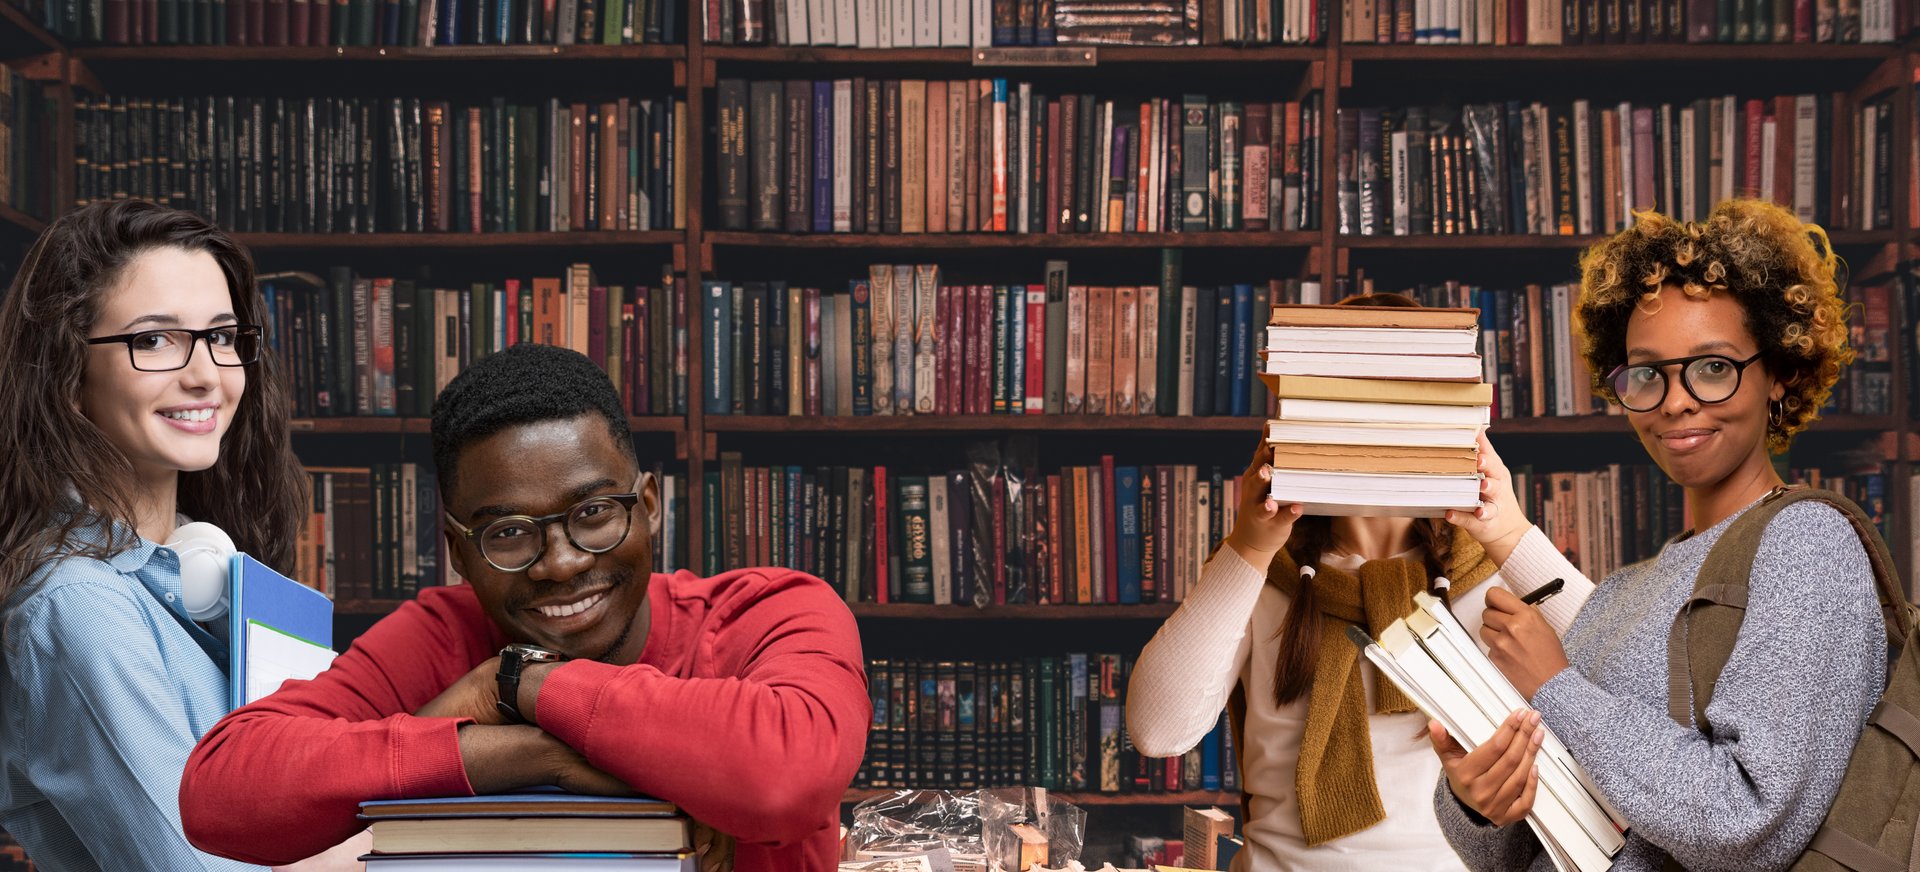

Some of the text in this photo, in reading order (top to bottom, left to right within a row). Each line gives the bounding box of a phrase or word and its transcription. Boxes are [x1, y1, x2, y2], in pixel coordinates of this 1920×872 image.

[1160, 501, 1168, 527] АМЕРИКА
[912, 515, 927, 559] ФРАЗЕР
[1144, 535, 1154, 579] АМЕРИКА
